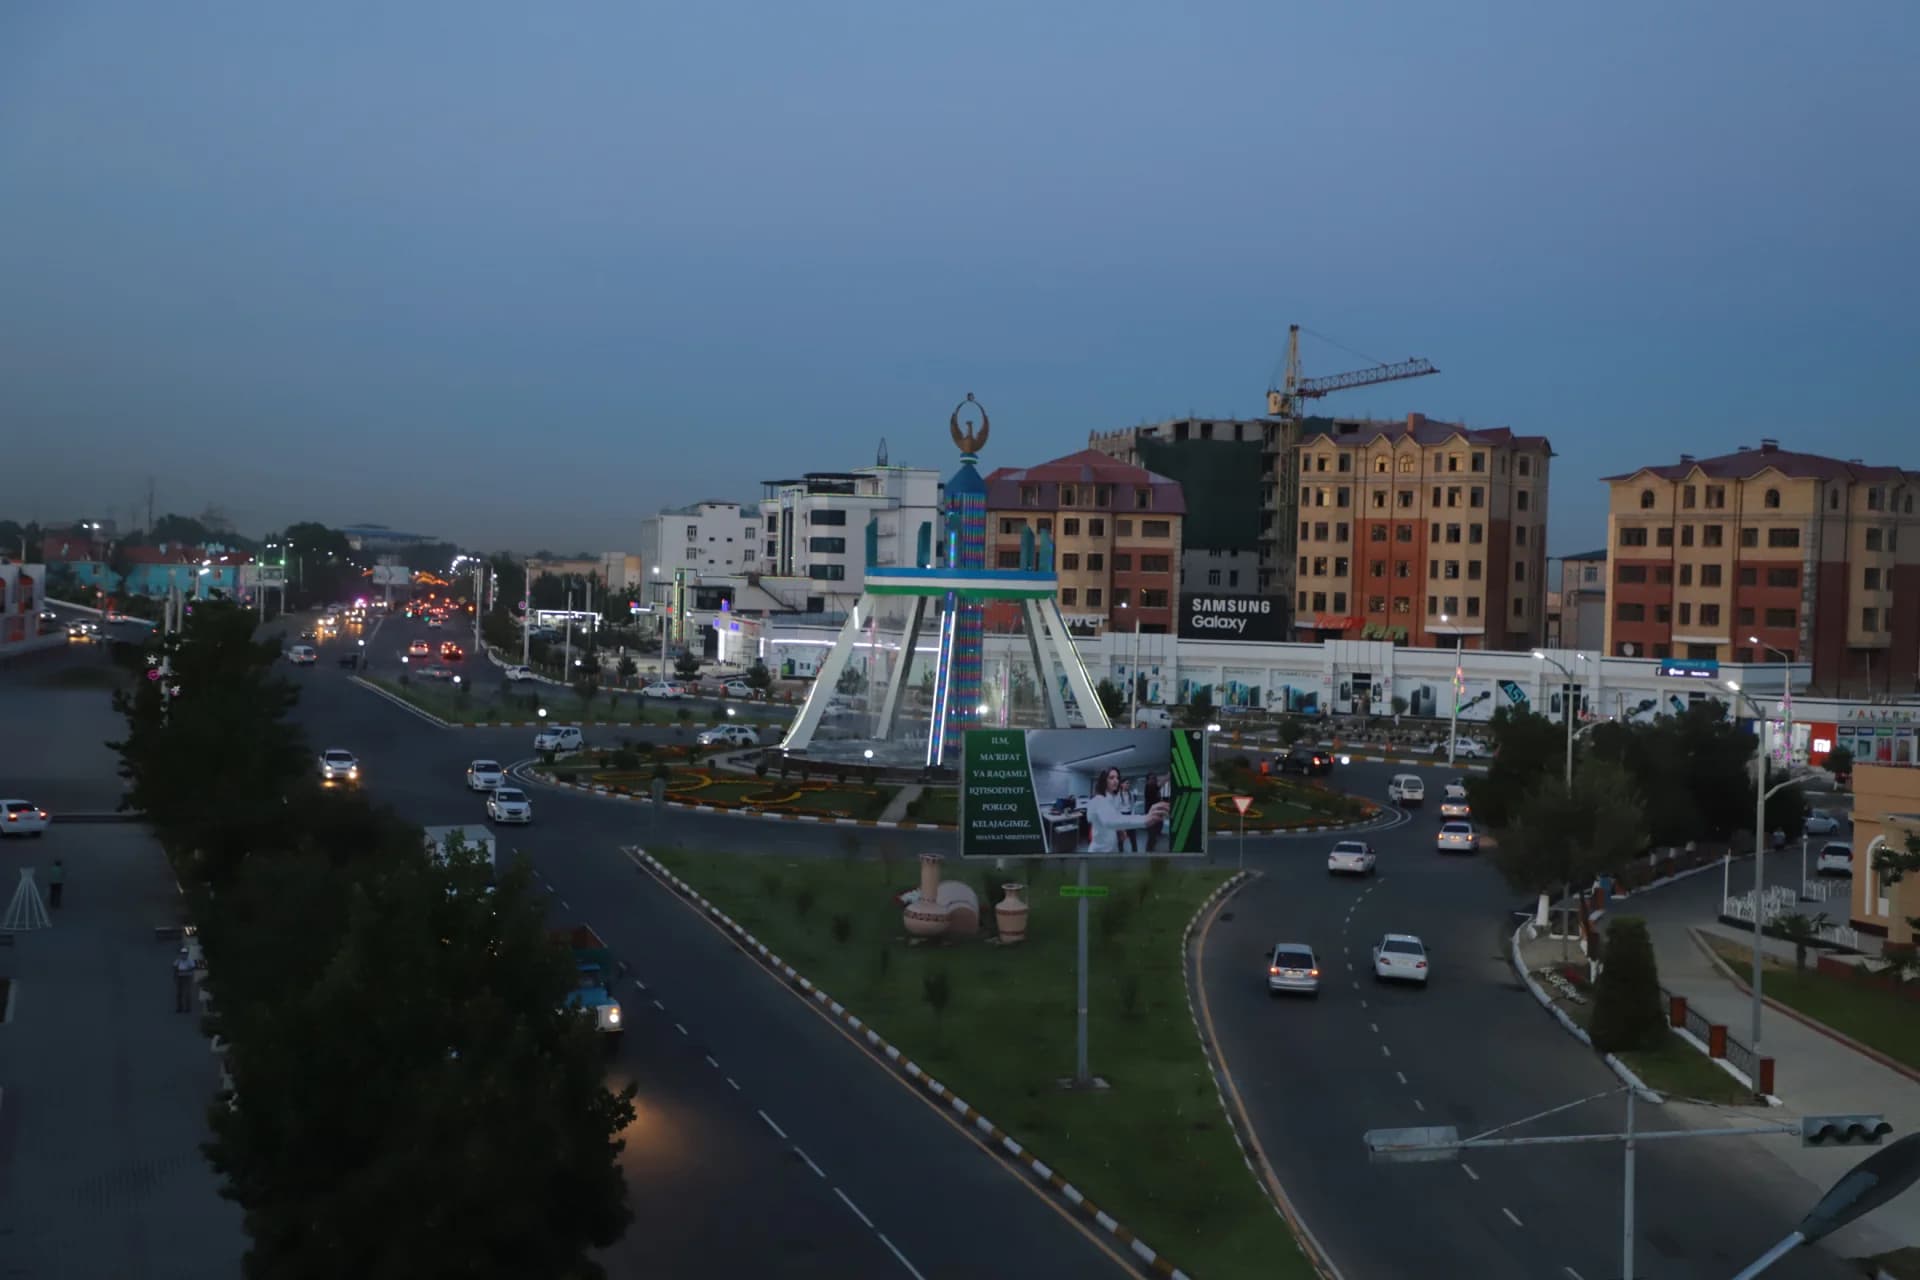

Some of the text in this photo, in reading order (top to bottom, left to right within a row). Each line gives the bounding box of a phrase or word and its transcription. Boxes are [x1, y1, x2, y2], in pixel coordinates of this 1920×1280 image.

[1192, 598, 1271, 614] SAMSUNG
[1192, 614, 1248, 634] Galaxy
[972, 769, 1027, 780] VA RAQAMLI
[968, 786, 1025, 796] IQTISODIYOT
[982, 802, 1018, 812] PORLOQ
